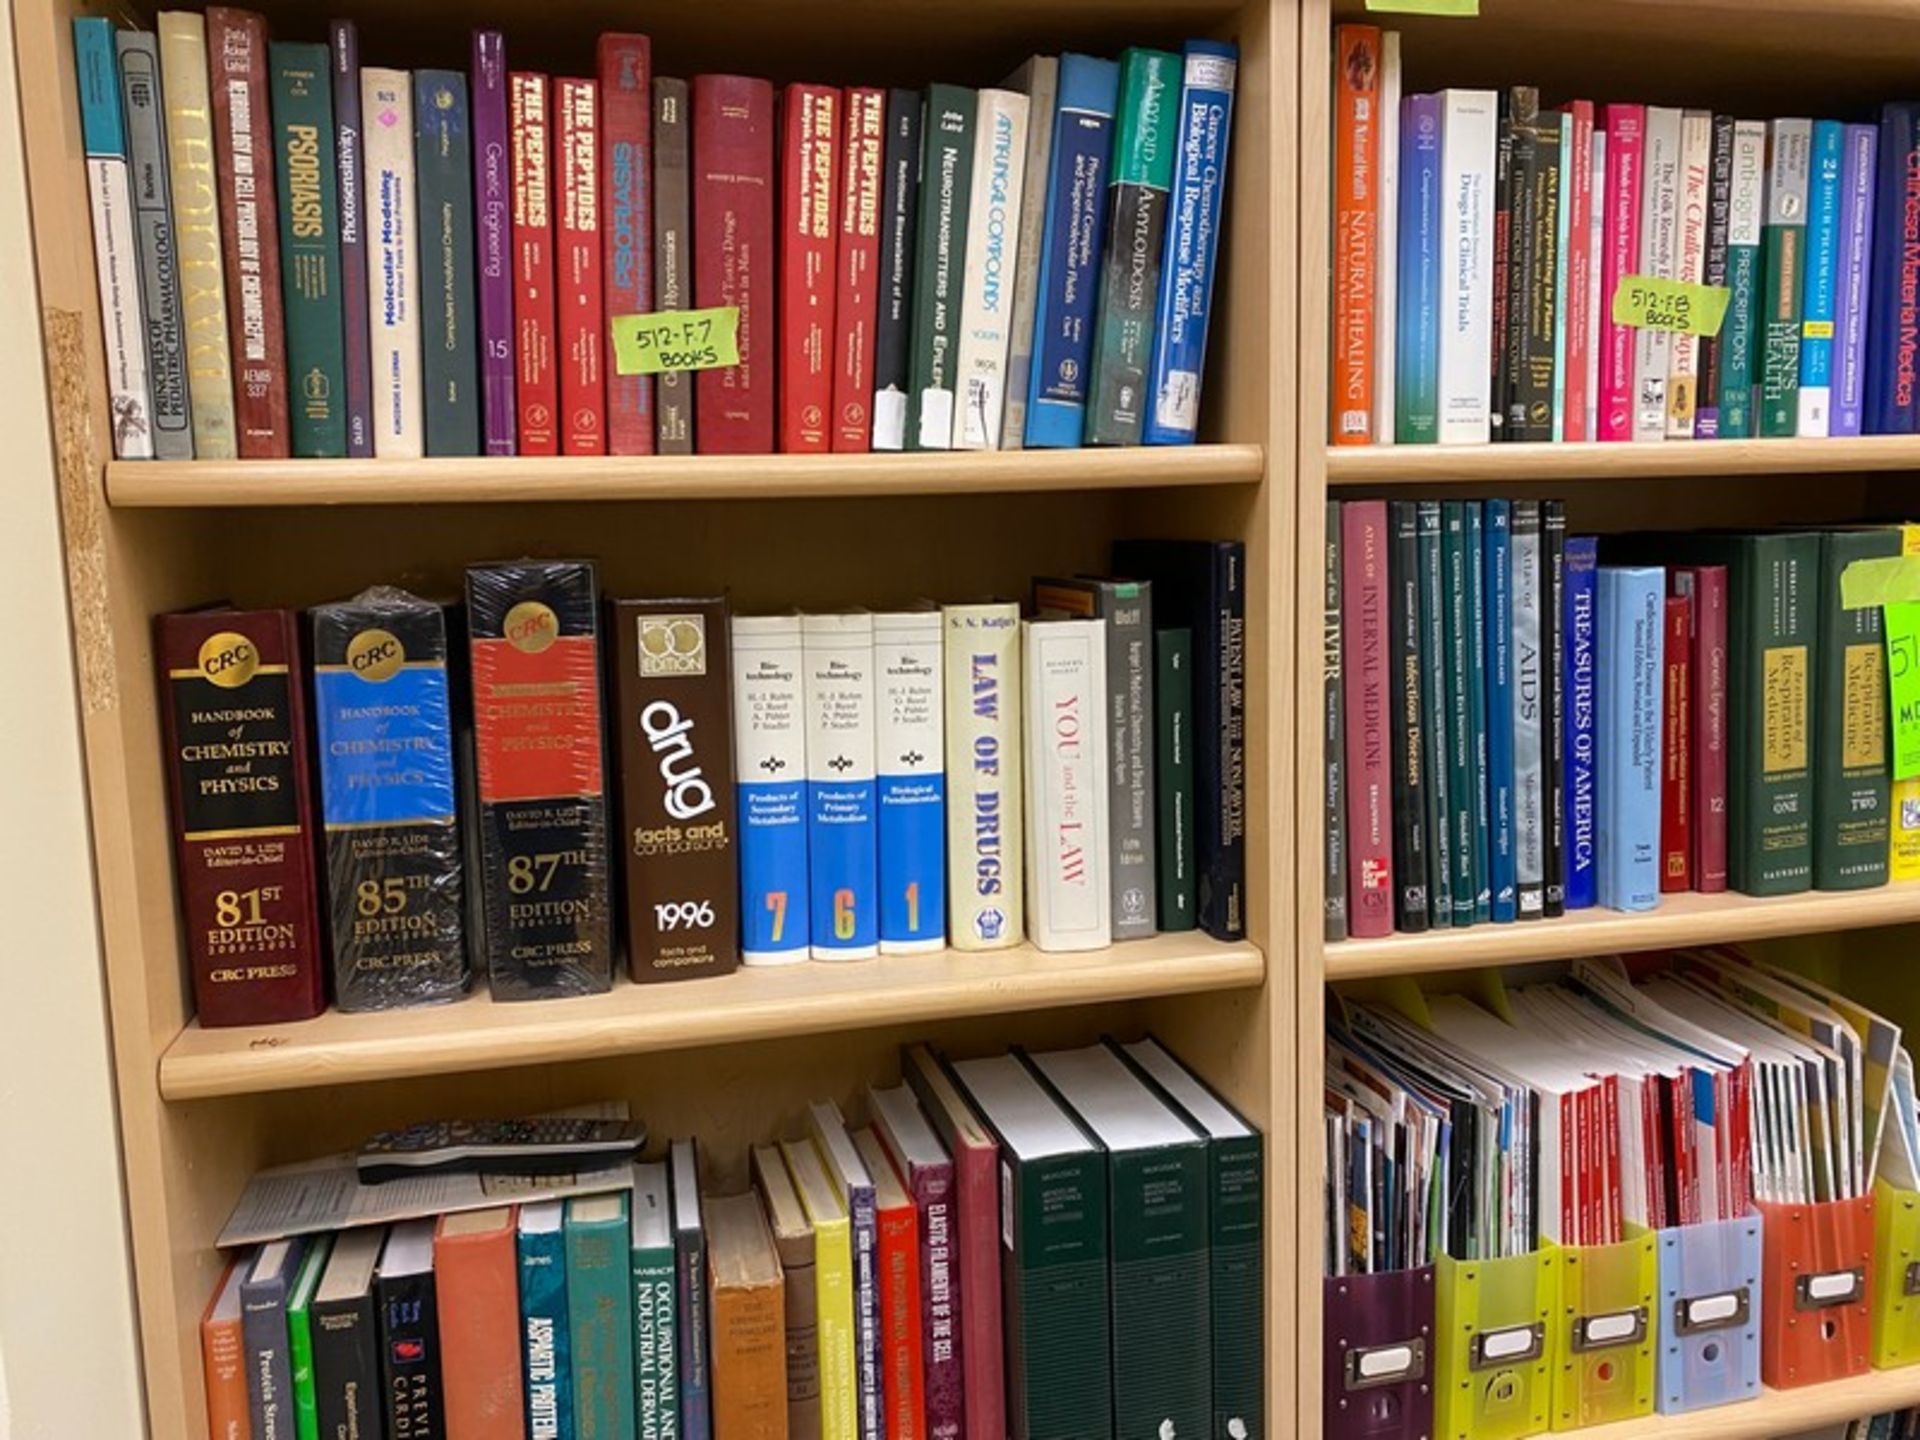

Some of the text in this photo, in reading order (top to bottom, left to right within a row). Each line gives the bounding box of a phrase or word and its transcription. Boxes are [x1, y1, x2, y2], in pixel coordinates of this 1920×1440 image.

[523, 76, 545, 122] THE
[574, 84, 594, 128] THE
[815, 95, 832, 138] THE
[861, 94, 882, 136] THE
[1140, 76, 1165, 163] AMYLOID
[1203, 105, 1223, 164] Cancer
[287, 124, 322, 235] PSORIASIS
[340, 125, 358, 242] Photosensitivity
[522, 124, 549, 227] PEPTIDES
[572, 131, 597, 231] PEPTIDES
[811, 141, 832, 237] PEPTIDES
[856, 139, 881, 235] PEPTIDES
[1073, 153, 1086, 177] and
[482, 142, 504, 277] Genetic Engineering
[613, 141, 632, 287] PSORIASIS
[1074, 155, 1100, 266] Physics of Complex
[1657, 163, 1673, 266] The Folk Remedy
[1733, 143, 1756, 240] anti-aging
[379, 169, 395, 324] Molecular Modeling
[442, 202, 453, 244] Chemistry
[1126, 187, 1155, 310] AMYLOIDOSIS
[1171, 102, 1208, 345] Biological Response Modifiers
[1189, 165, 1217, 283] Chemotherapy
[1681, 165, 1704, 283] The Challeng
[443, 247, 454, 289] Analytical
[661, 230, 677, 305] Hypertension
[983, 207, 1003, 312] COMPOUNDS
[1457, 174, 1472, 332] Drugs in Clinical Trials
[1063, 270, 1077, 304] Fluids
[1189, 285, 1204, 315] and
[1345, 209, 1369, 399] NATURAL HEALING
[1731, 248, 1749, 370] PRESCRIPTIONS
[1900, 241, 1920, 326] Materia
[153, 218, 182, 415] PEDIATRIC PHARMACOLOGY
[445, 301, 455, 350] Computers
[151, 317, 170, 414] PRINCIPLES OF
[489, 339, 508, 358] 15
[660, 347, 717, 367] BOOKS
[1763, 321, 1785, 400] HEALTH
[1777, 321, 1800, 392] MEN'S
[1896, 327, 1916, 408] Medica
[247, 384, 267, 397] 337
[1425, 517, 1439, 528] VII
[509, 612, 550, 641] CRC
[1322, 543, 1340, 680] Atlas of the LIVER
[1523, 593, 1535, 609] of
[203, 644, 250, 675] CRC
[352, 640, 395, 670] CRC
[1361, 526, 1381, 769] ATLAS OF INTERNAL MEDICINE
[1520, 642, 1539, 721] AIDS
[1643, 592, 1656, 790] Cardiovascular Disease in the Elderly Patient
[1707, 648, 1724, 751] Genetic Engineering
[1854, 651, 1879, 760] Respiratory
[192, 708, 275, 723] HANDBOOK
[228, 725, 243, 739] of
[340, 706, 420, 719] HANDBOOK
[488, 703, 589, 720] CHEMISTRY
[1229, 618, 1242, 838] PATENT LAW NONLAWYER
[1574, 588, 1592, 871] TREASURES OF AMERICA
[1763, 666, 1781, 755] Medicine
[1772, 654, 1797, 763] Respiratory
[1842, 664, 1864, 753] Medicine
[181, 741, 291, 761] CHEMISTRY
[226, 762, 251, 773] and
[331, 737, 433, 754] CHEMISTRY
[501, 735, 575, 751] PHYSICS
[640, 700, 716, 820] drug
[200, 776, 279, 794] PHYSICS
[348, 772, 423, 788] PHYSICS
[749, 791, 799, 803] Products of
[818, 790, 867, 801] Products of
[972, 654, 1001, 895] LAW OF DRUGS
[1055, 696, 1084, 886] YOU and the LAW
[751, 804, 796, 814] Secondary
[825, 804, 860, 814] Primary
[1369, 784, 1380, 844] BRAUNWALD
[1773, 800, 1798, 814] ONE
[1851, 797, 1877, 811] TWO
[634, 821, 723, 845] facts and
[355, 911, 436, 934] EDITION
[510, 899, 590, 918] EDITION
[654, 900, 715, 932] 1996
[767, 892, 787, 942] 7
[835, 889, 855, 940] 6
[906, 883, 919, 932] 1
[208, 924, 294, 944] EDITION
[511, 940, 592, 959] CRC PRESS
[686, 944, 706, 953] and
[210, 965, 297, 982] CRC PRESS
[356, 957, 388, 970] CRC
[652, 954, 714, 968] comparisons
[525, 1255, 552, 1266] James
[927, 1203, 952, 1363] ELASTIC FILAMENTS OF THE CELL
[527, 1316, 555, 1381] ASPARTIC
[634, 1281, 657, 1374] INDUSTRIAL
[652, 1280, 677, 1404] OCCUPATIONAL
[259, 1349, 278, 1401] Protein
